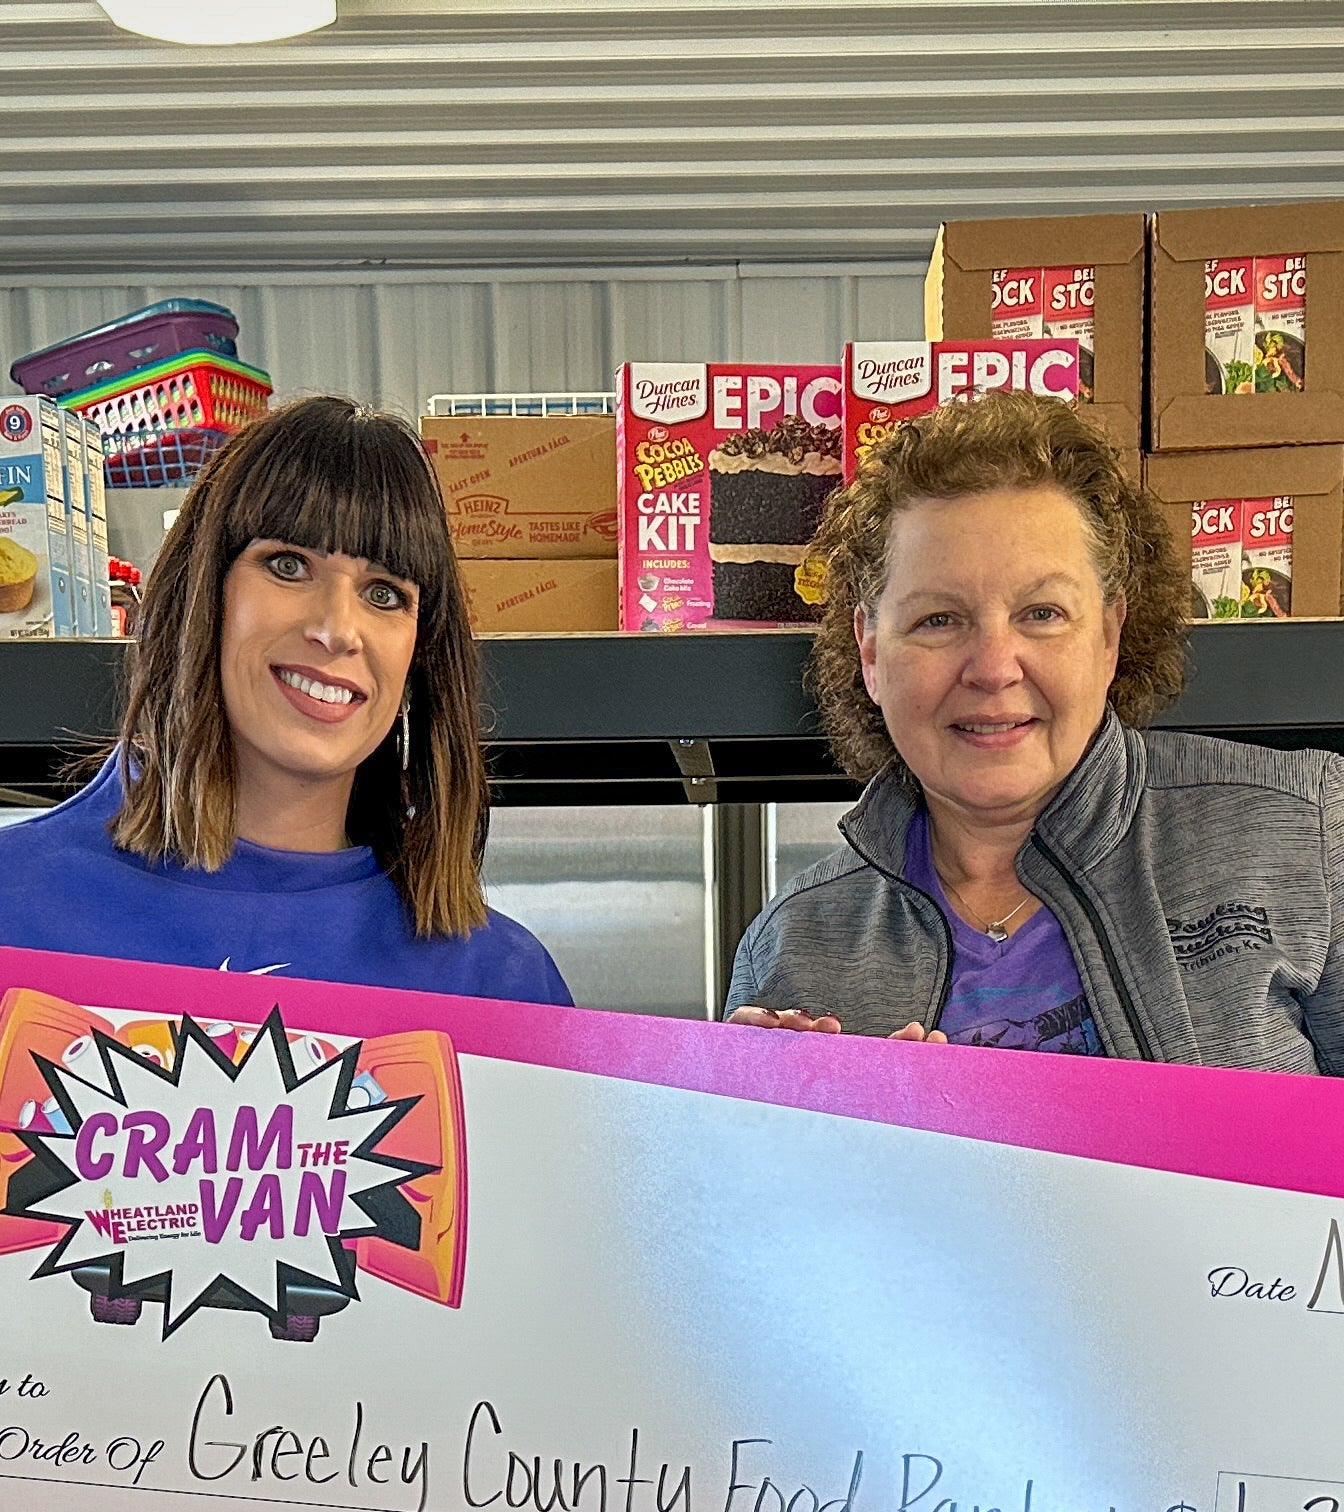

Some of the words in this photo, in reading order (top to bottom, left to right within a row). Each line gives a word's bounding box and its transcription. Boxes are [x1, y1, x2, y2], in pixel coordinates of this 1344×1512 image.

[858, 356, 925, 380] Duncan
[938, 349, 1076, 408] EPIC
[636, 378, 700, 400] Duncan
[867, 371, 921, 395] Hines
[645, 393, 696, 415] Hines
[713, 375, 844, 430] EPIC
[9, 415, 20, 430] 9
[635, 437, 695, 466] COCOA
[634, 453, 704, 492] PEBBLES
[463, 500, 501, 514] HEINZ
[637, 493, 700, 514] CAKE
[529, 521, 561, 532] TASTES
[561, 521, 581, 532] LIKE
[529, 532, 581, 543] HOMEMADE
[638, 515, 701, 551] KIT
[75, 1104, 294, 1183] CRAM
[297, 1141, 349, 1167] THE
[84, 1203, 199, 1238] WHEATLAND
[199, 1169, 347, 1244] VAN
[113, 1215, 197, 1245] ELECTRIC
[1207, 1265, 1297, 1302] Date
[17, 1374, 51, 1400] to
[107, 1436, 166, 1485] Of
